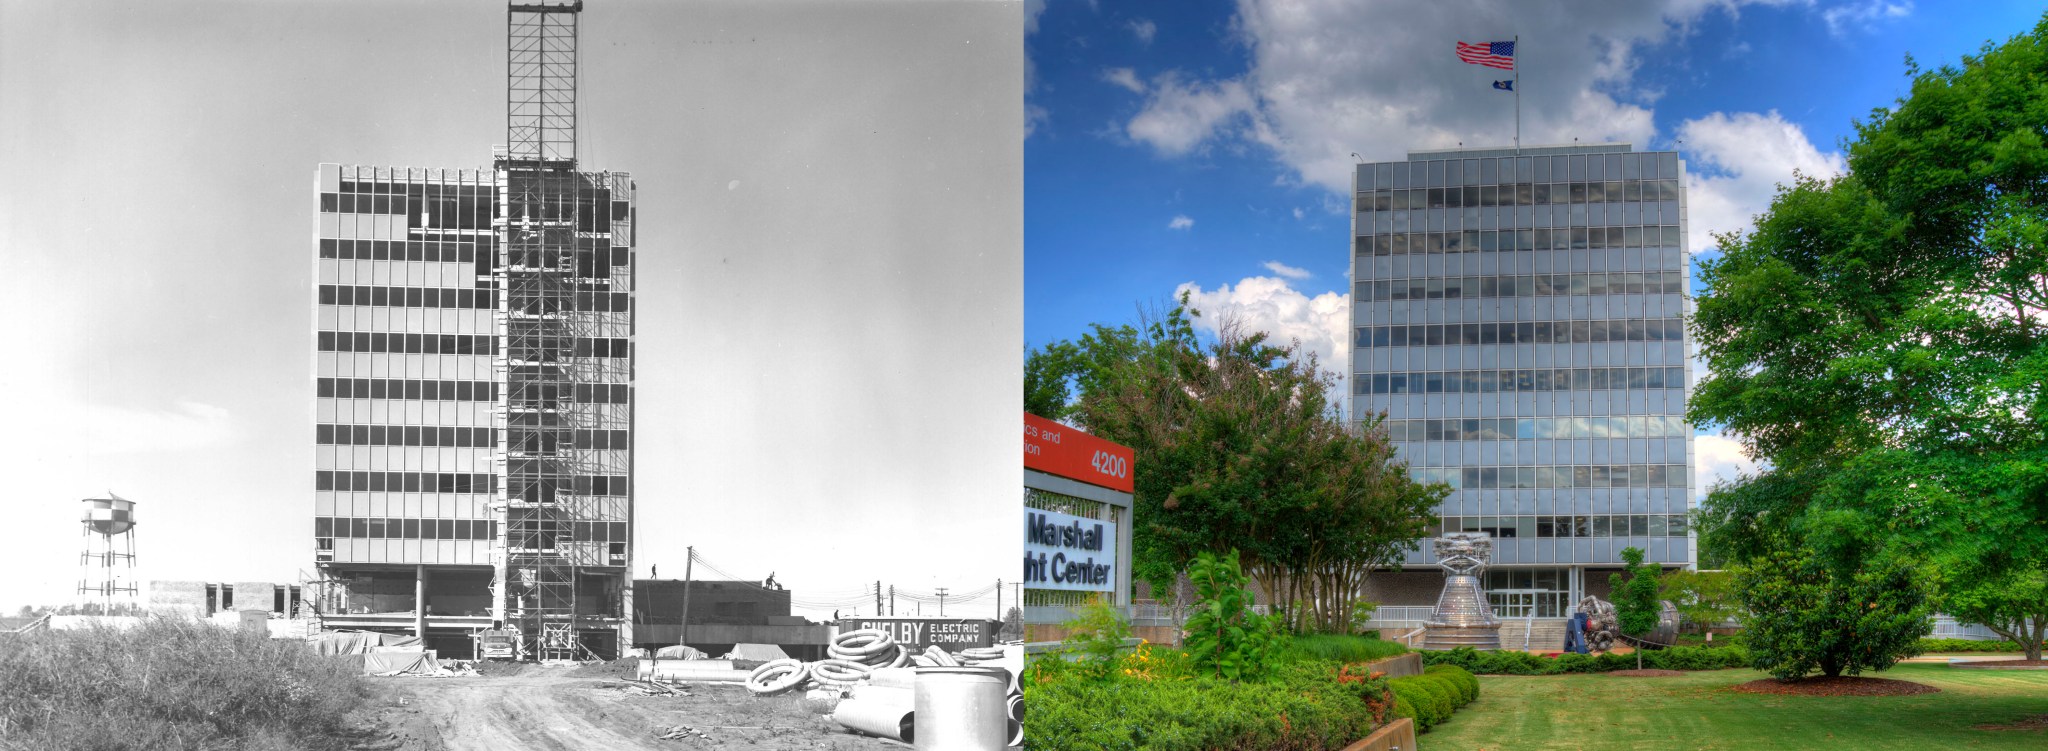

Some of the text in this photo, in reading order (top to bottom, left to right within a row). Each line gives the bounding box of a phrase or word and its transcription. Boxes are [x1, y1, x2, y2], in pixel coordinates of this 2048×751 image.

[1042, 430, 1060, 444] and
[1024, 440, 1040, 456] ion
[1091, 449, 1126, 479] 4200
[1027, 511, 1103, 551] Marshall
[1024, 550, 1110, 585] ht Center
[930, 623, 979, 633] ELECTRIC
[930, 633, 979, 643] COMPANY
